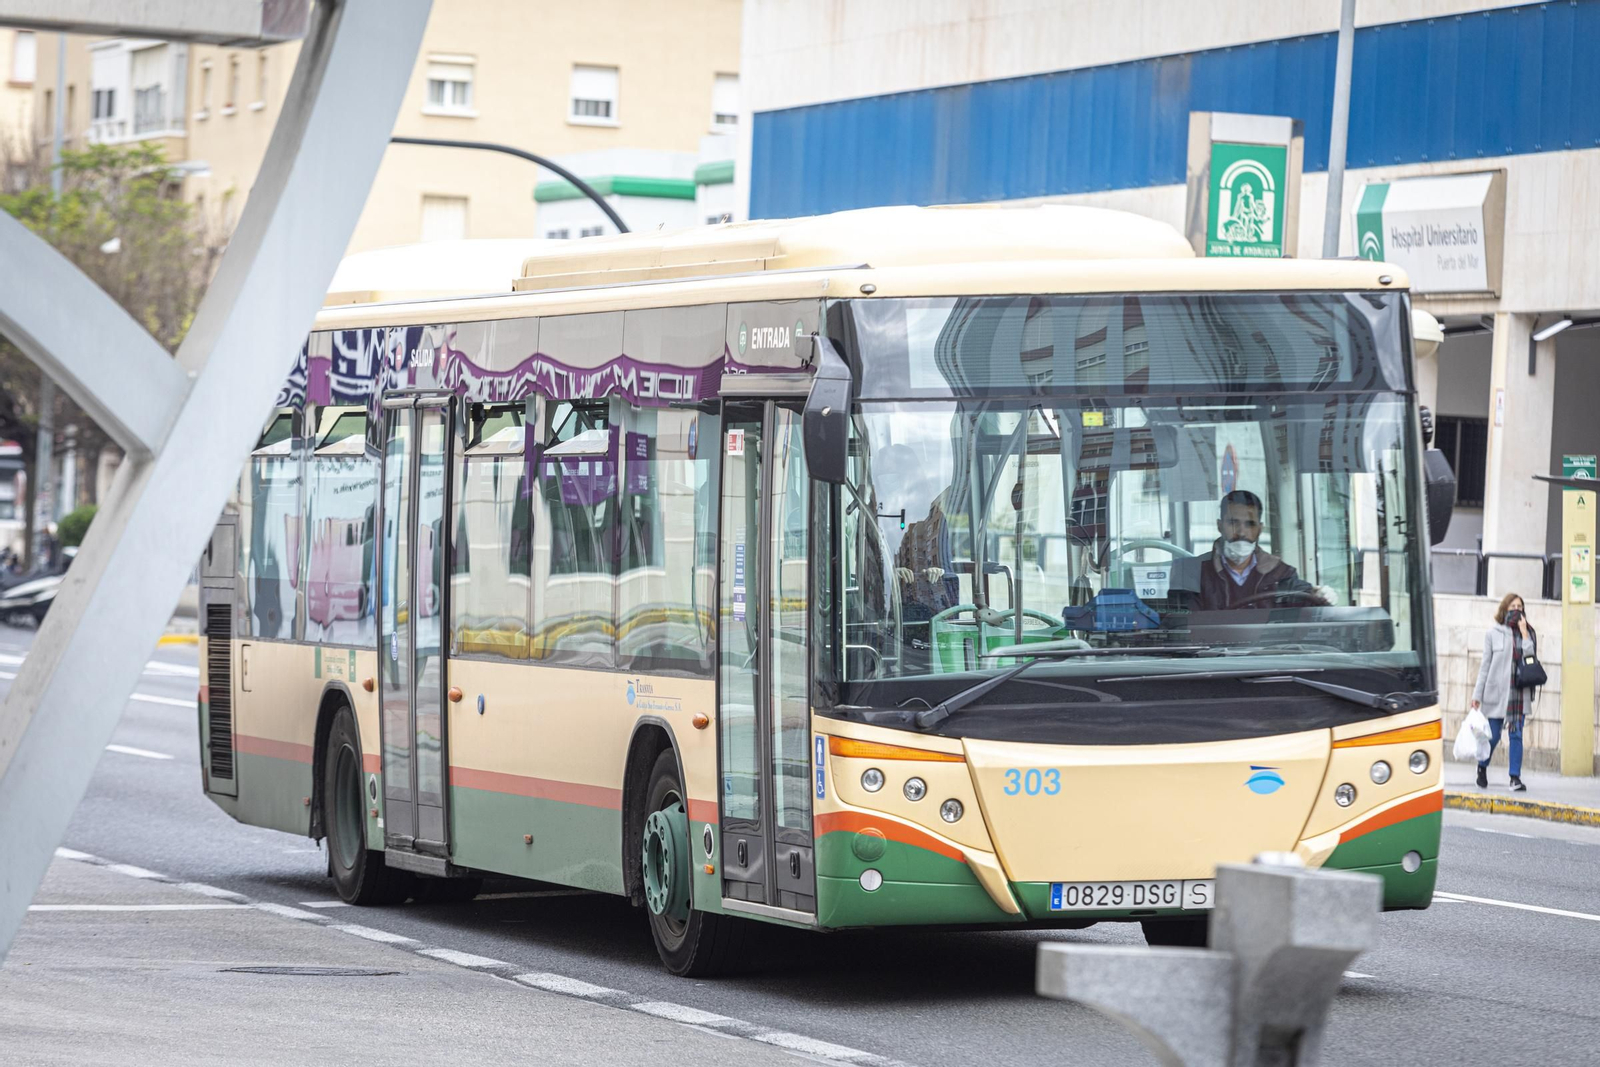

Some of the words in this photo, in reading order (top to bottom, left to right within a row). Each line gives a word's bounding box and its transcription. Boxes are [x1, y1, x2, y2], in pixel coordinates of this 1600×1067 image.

[1391, 225, 1424, 253] Hospital
[1426, 222, 1478, 247] Universitario
[1210, 245, 1231, 255] JUNTA
[1233, 246, 1241, 256] DE
[1437, 254, 1457, 271] Puerta
[1458, 254, 1466, 270] del
[1467, 253, 1479, 270] Mar
[751, 326, 790, 349] ENTRADA
[410, 348, 433, 368] SALIDA
[1142, 588, 1156, 596] NO
[1003, 768, 1061, 796] 303
[1066, 884, 1124, 906] 0829
[1133, 884, 1176, 906] DSG
[1191, 883, 1216, 905] S
